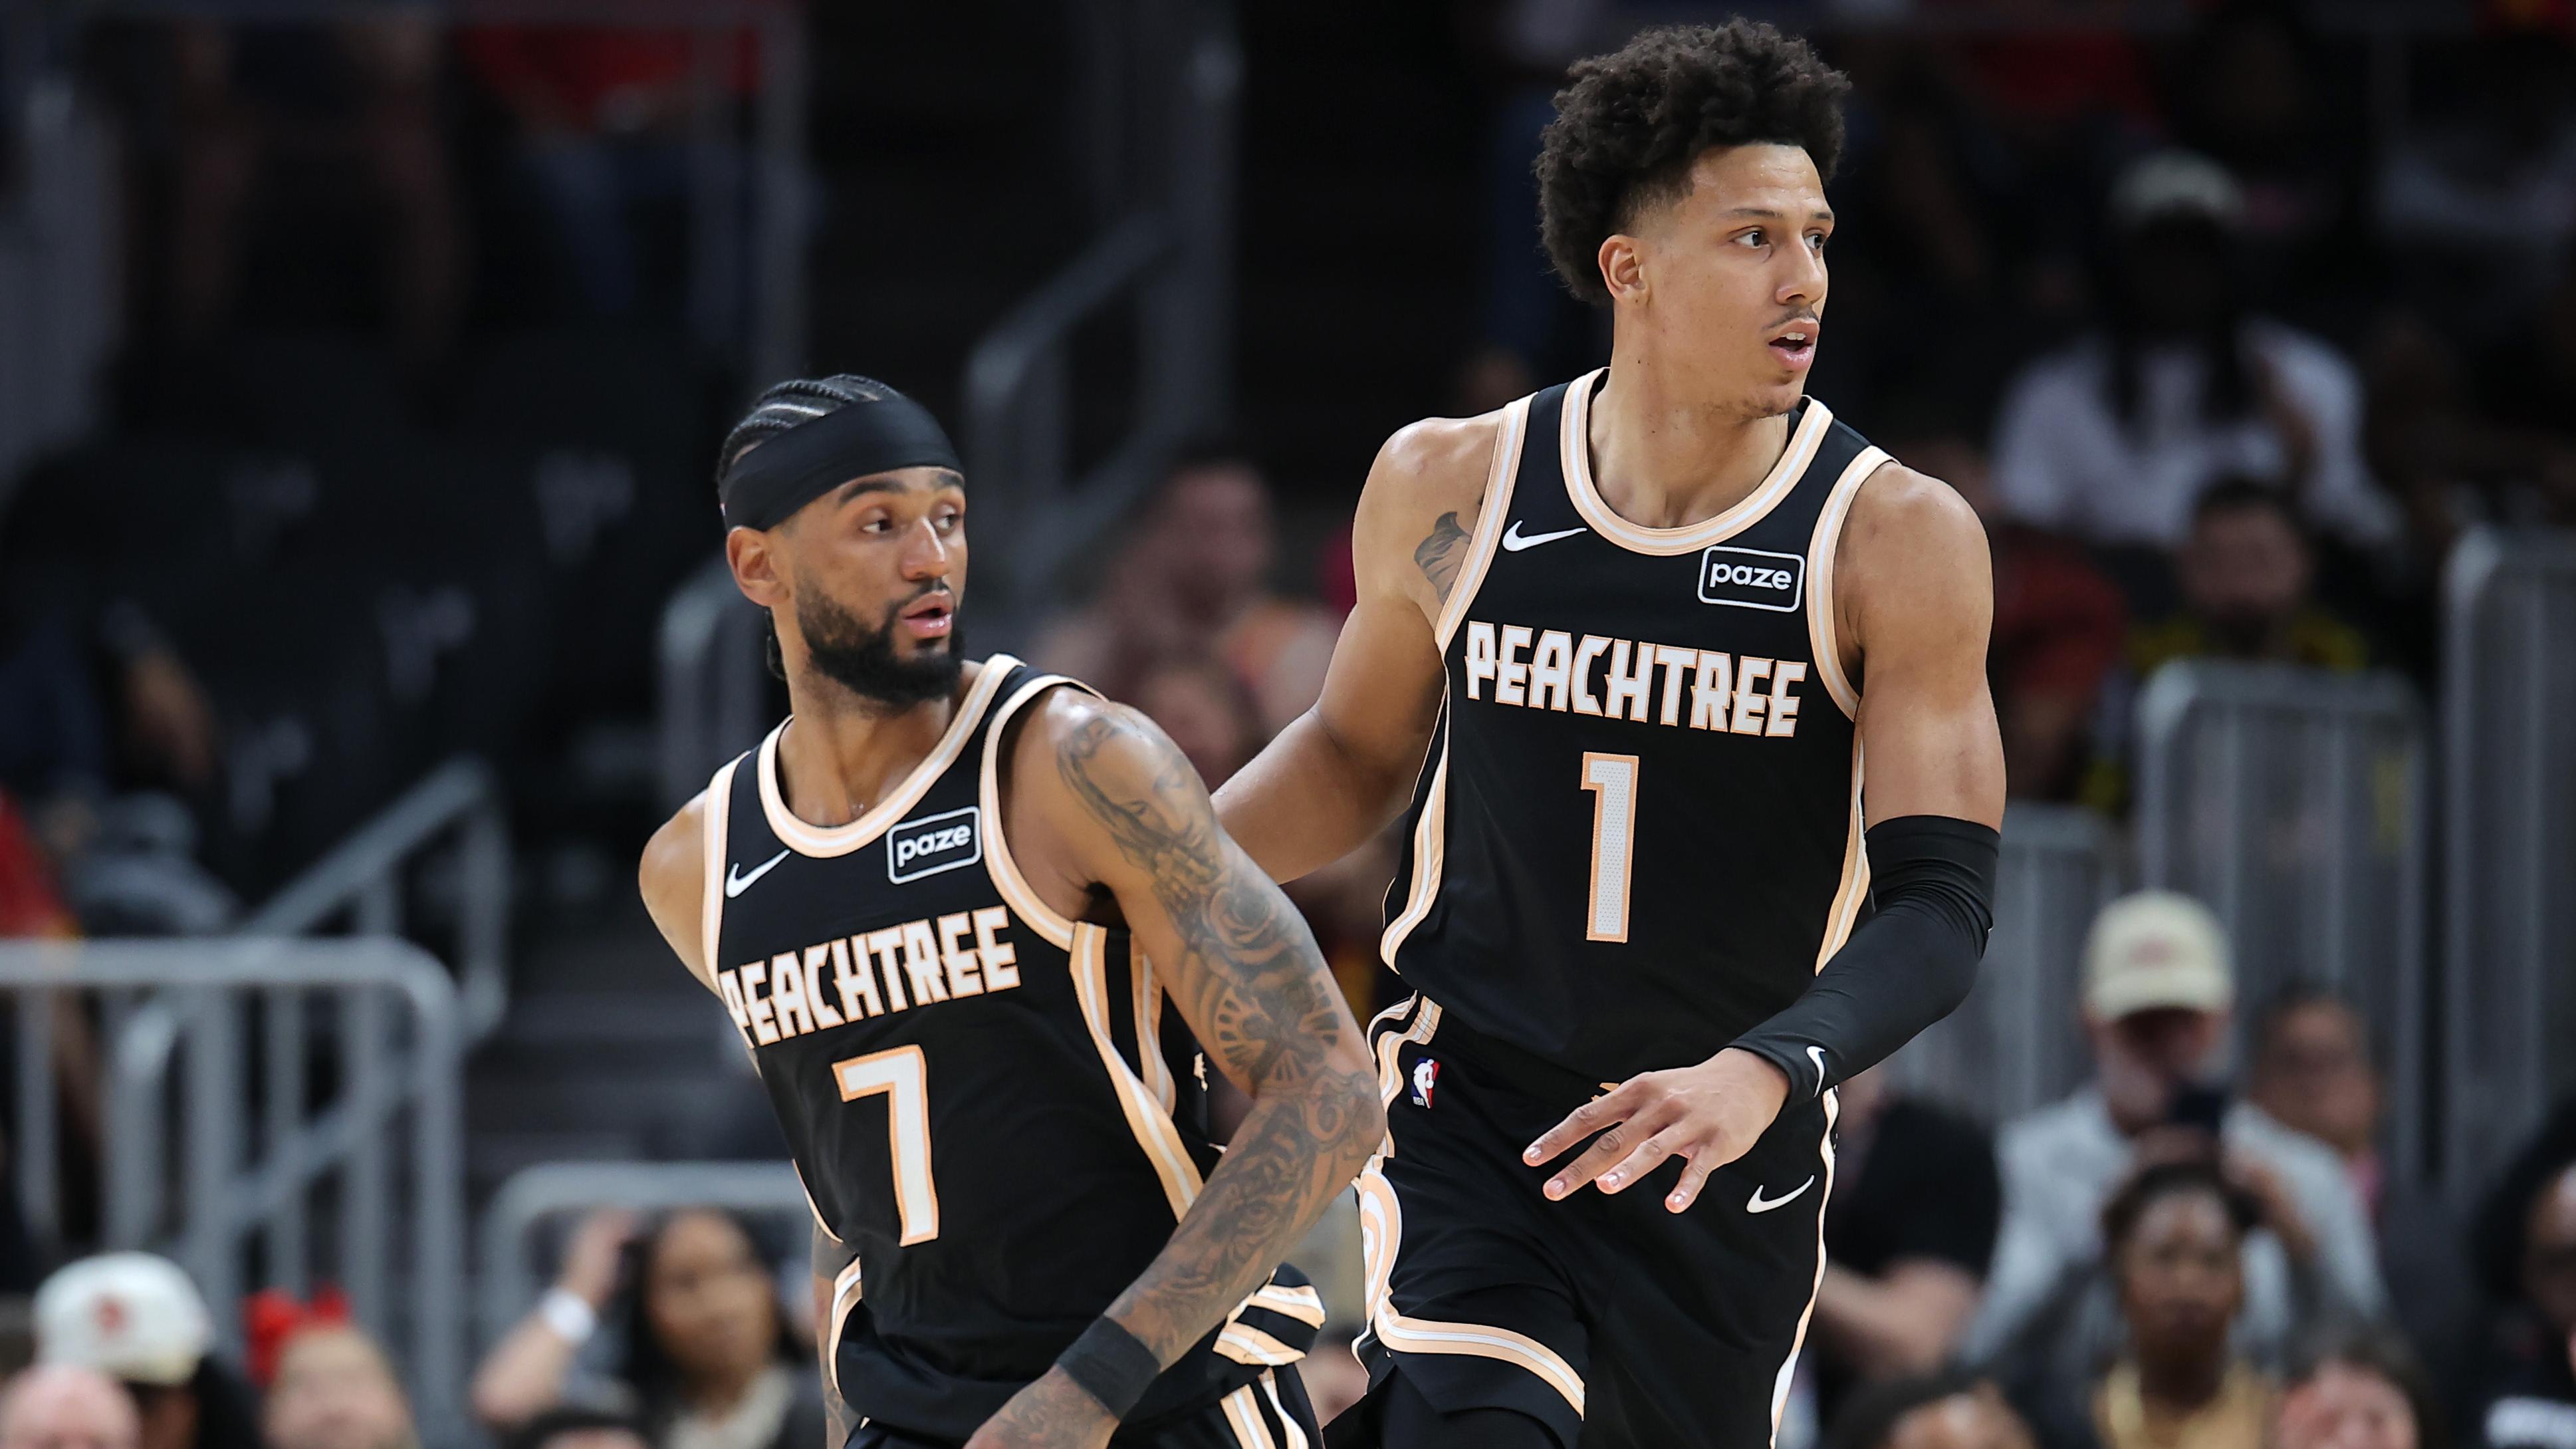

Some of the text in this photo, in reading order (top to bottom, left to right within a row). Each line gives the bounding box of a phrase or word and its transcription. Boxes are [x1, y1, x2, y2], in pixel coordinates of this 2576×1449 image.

[1710, 563, 1792, 591] paze
[1464, 621, 1808, 737] PEACHTREE
[897, 825, 971, 867] paze
[1580, 751, 1639, 943] 1
[719, 906, 1021, 1049] PEACHTREE
[832, 1044, 939, 1247] 7
